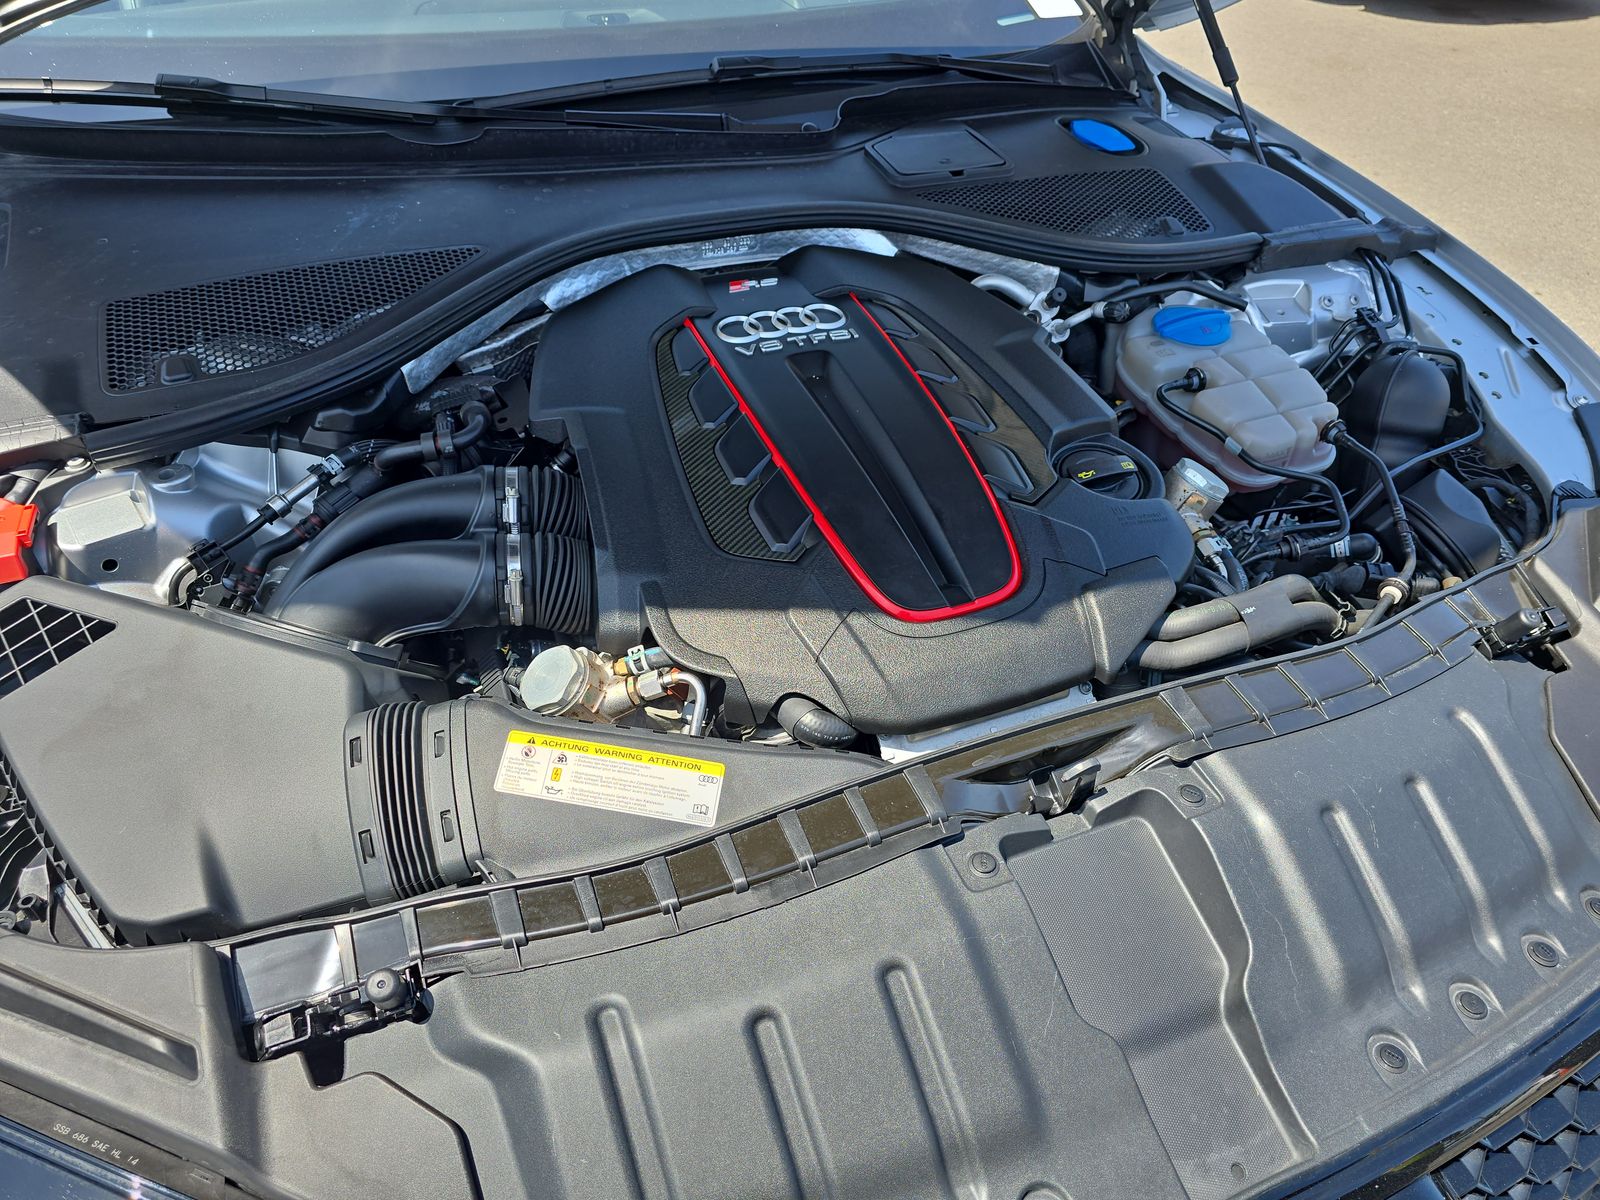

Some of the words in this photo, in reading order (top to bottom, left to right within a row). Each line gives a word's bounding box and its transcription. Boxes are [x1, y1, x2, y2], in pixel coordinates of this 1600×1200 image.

[735, 340, 783, 355] V8
[787, 328, 859, 346] TFSI
[541, 739, 589, 753] ACHTUNG
[595, 747, 643, 761] WARNING
[648, 756, 702, 771] ATTENTION
[53, 1123, 71, 1135] SSB
[91, 1140, 110, 1152] SAE
[111, 1148, 121, 1159] HL
[127, 1155, 140, 1166] 14
